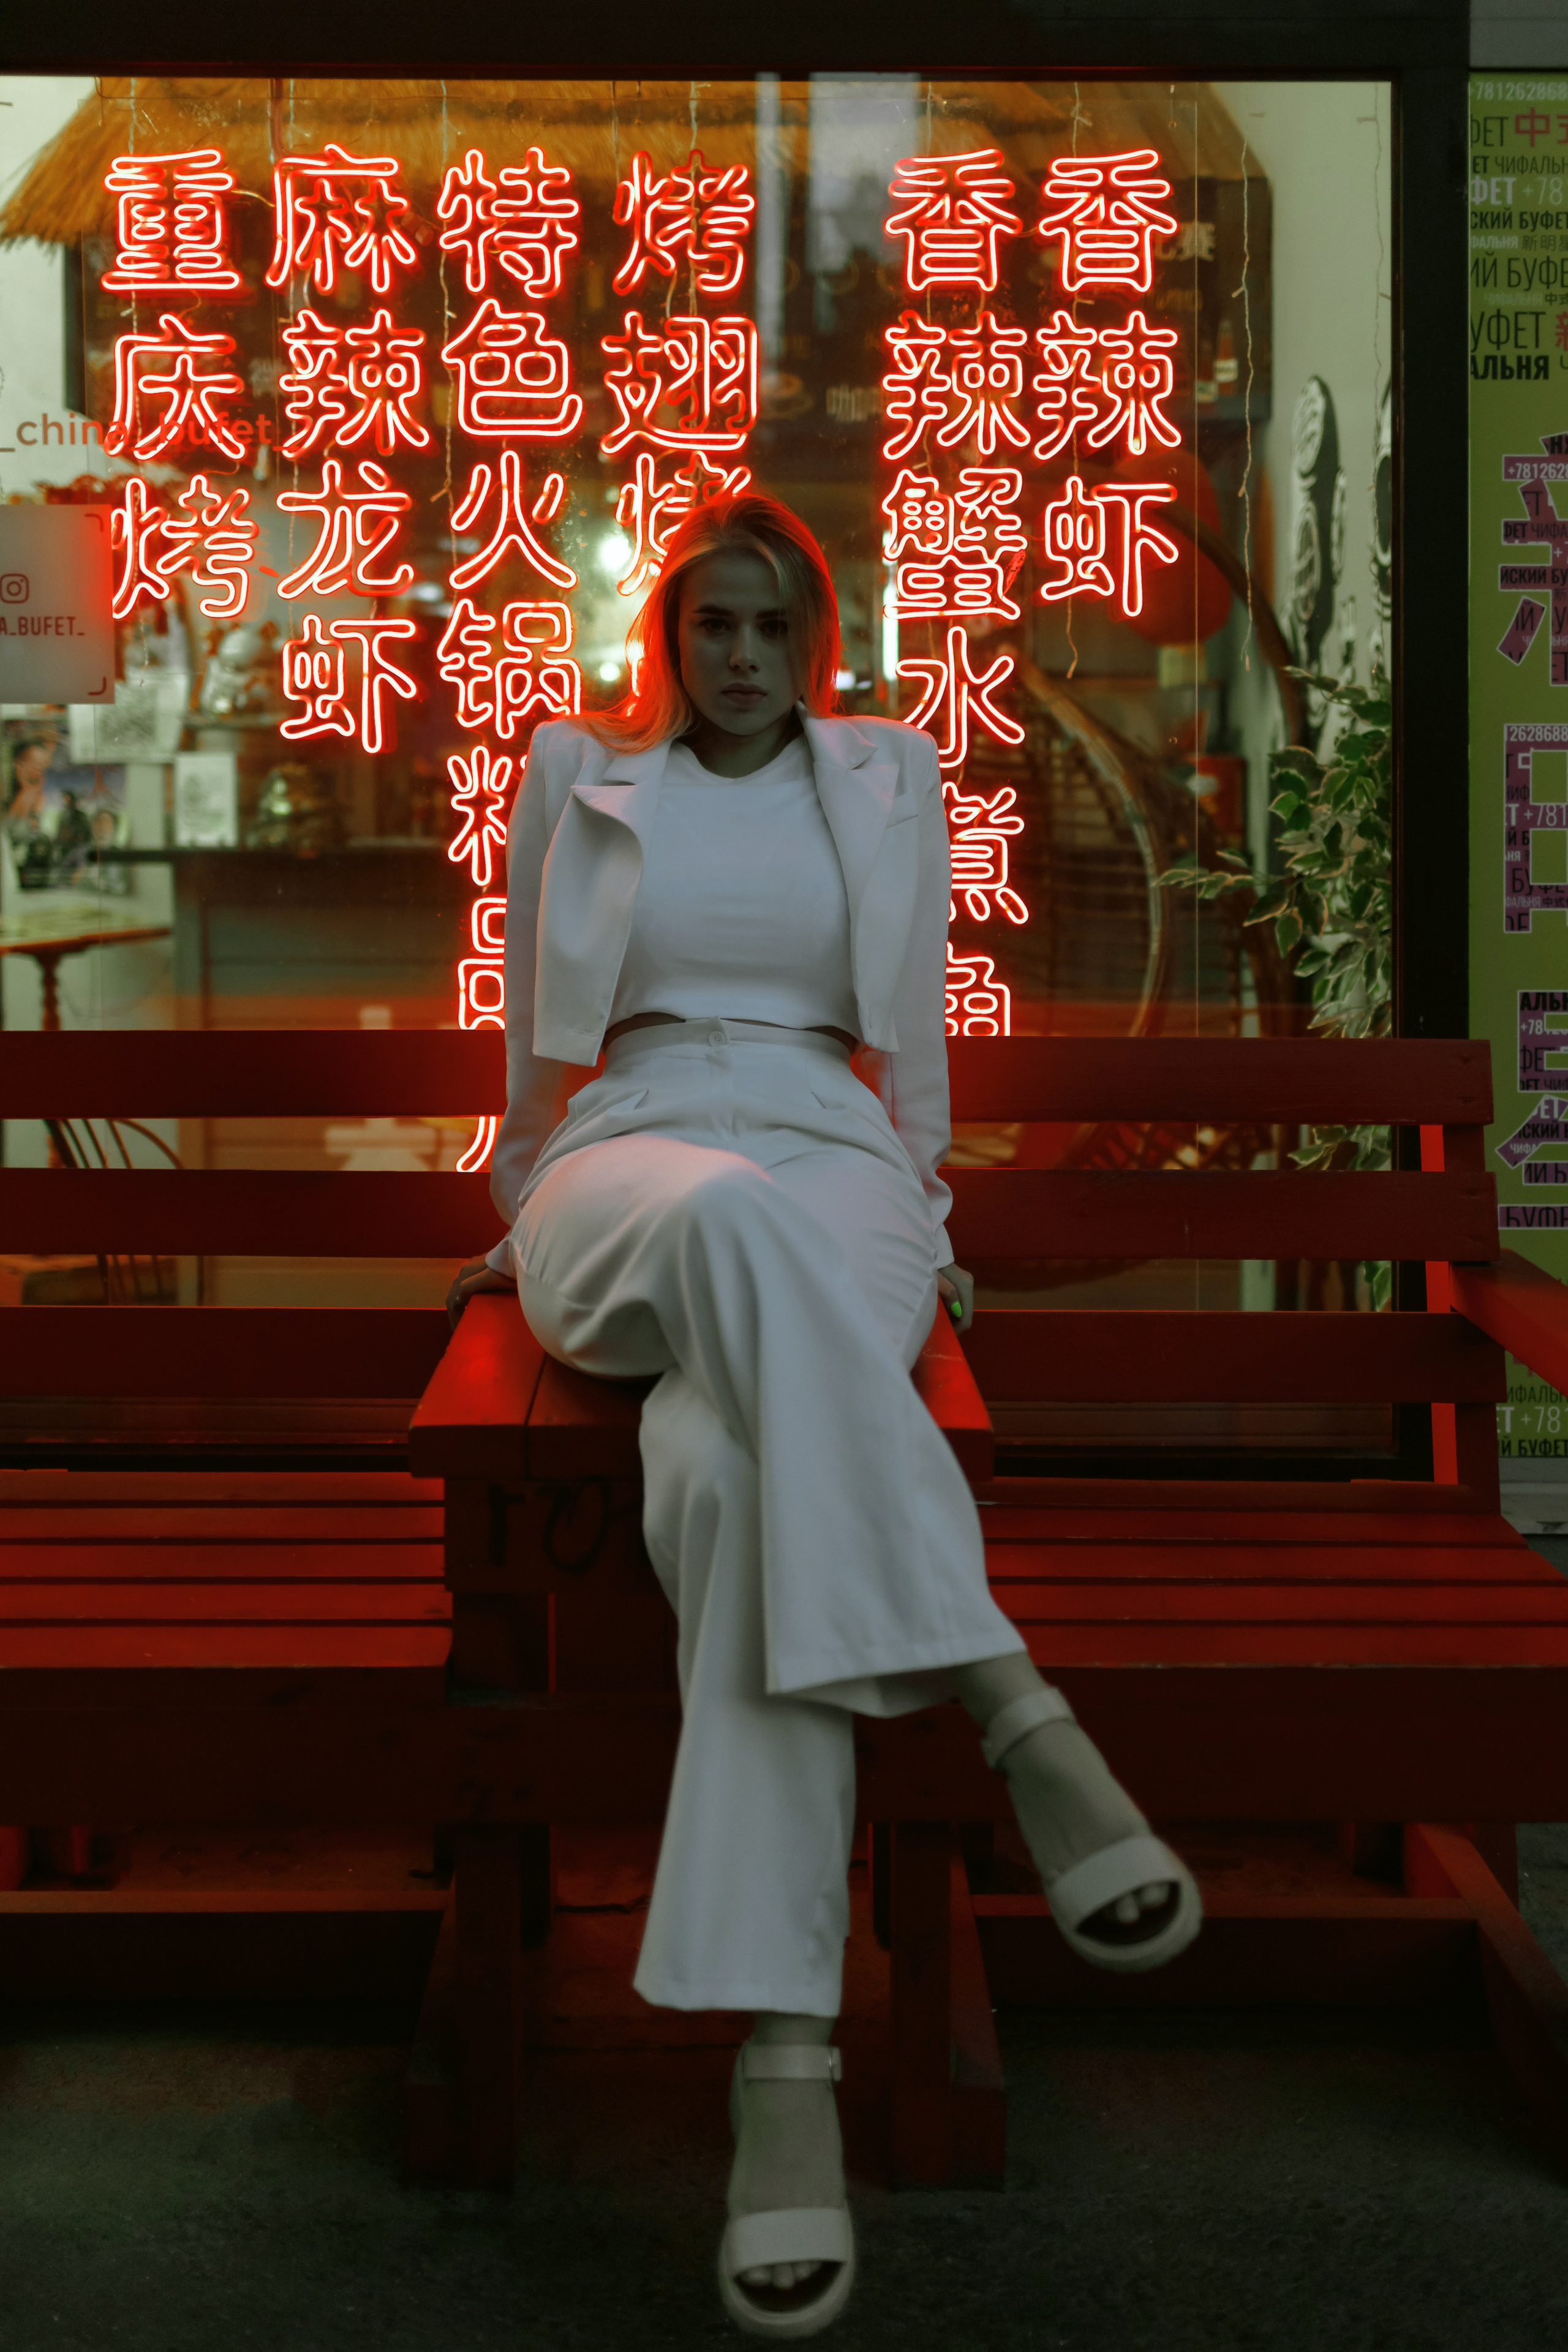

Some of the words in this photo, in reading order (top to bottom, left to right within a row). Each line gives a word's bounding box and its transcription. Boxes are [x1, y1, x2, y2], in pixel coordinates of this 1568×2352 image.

[100, 148, 258, 620] 重庆烤
[1033, 149, 1182, 617] 香辣虾
[1522, 176, 1568, 205] +78
[265, 144, 429, 754] 麻辣龙虾
[436, 146, 582, 1173] 特色火锅
